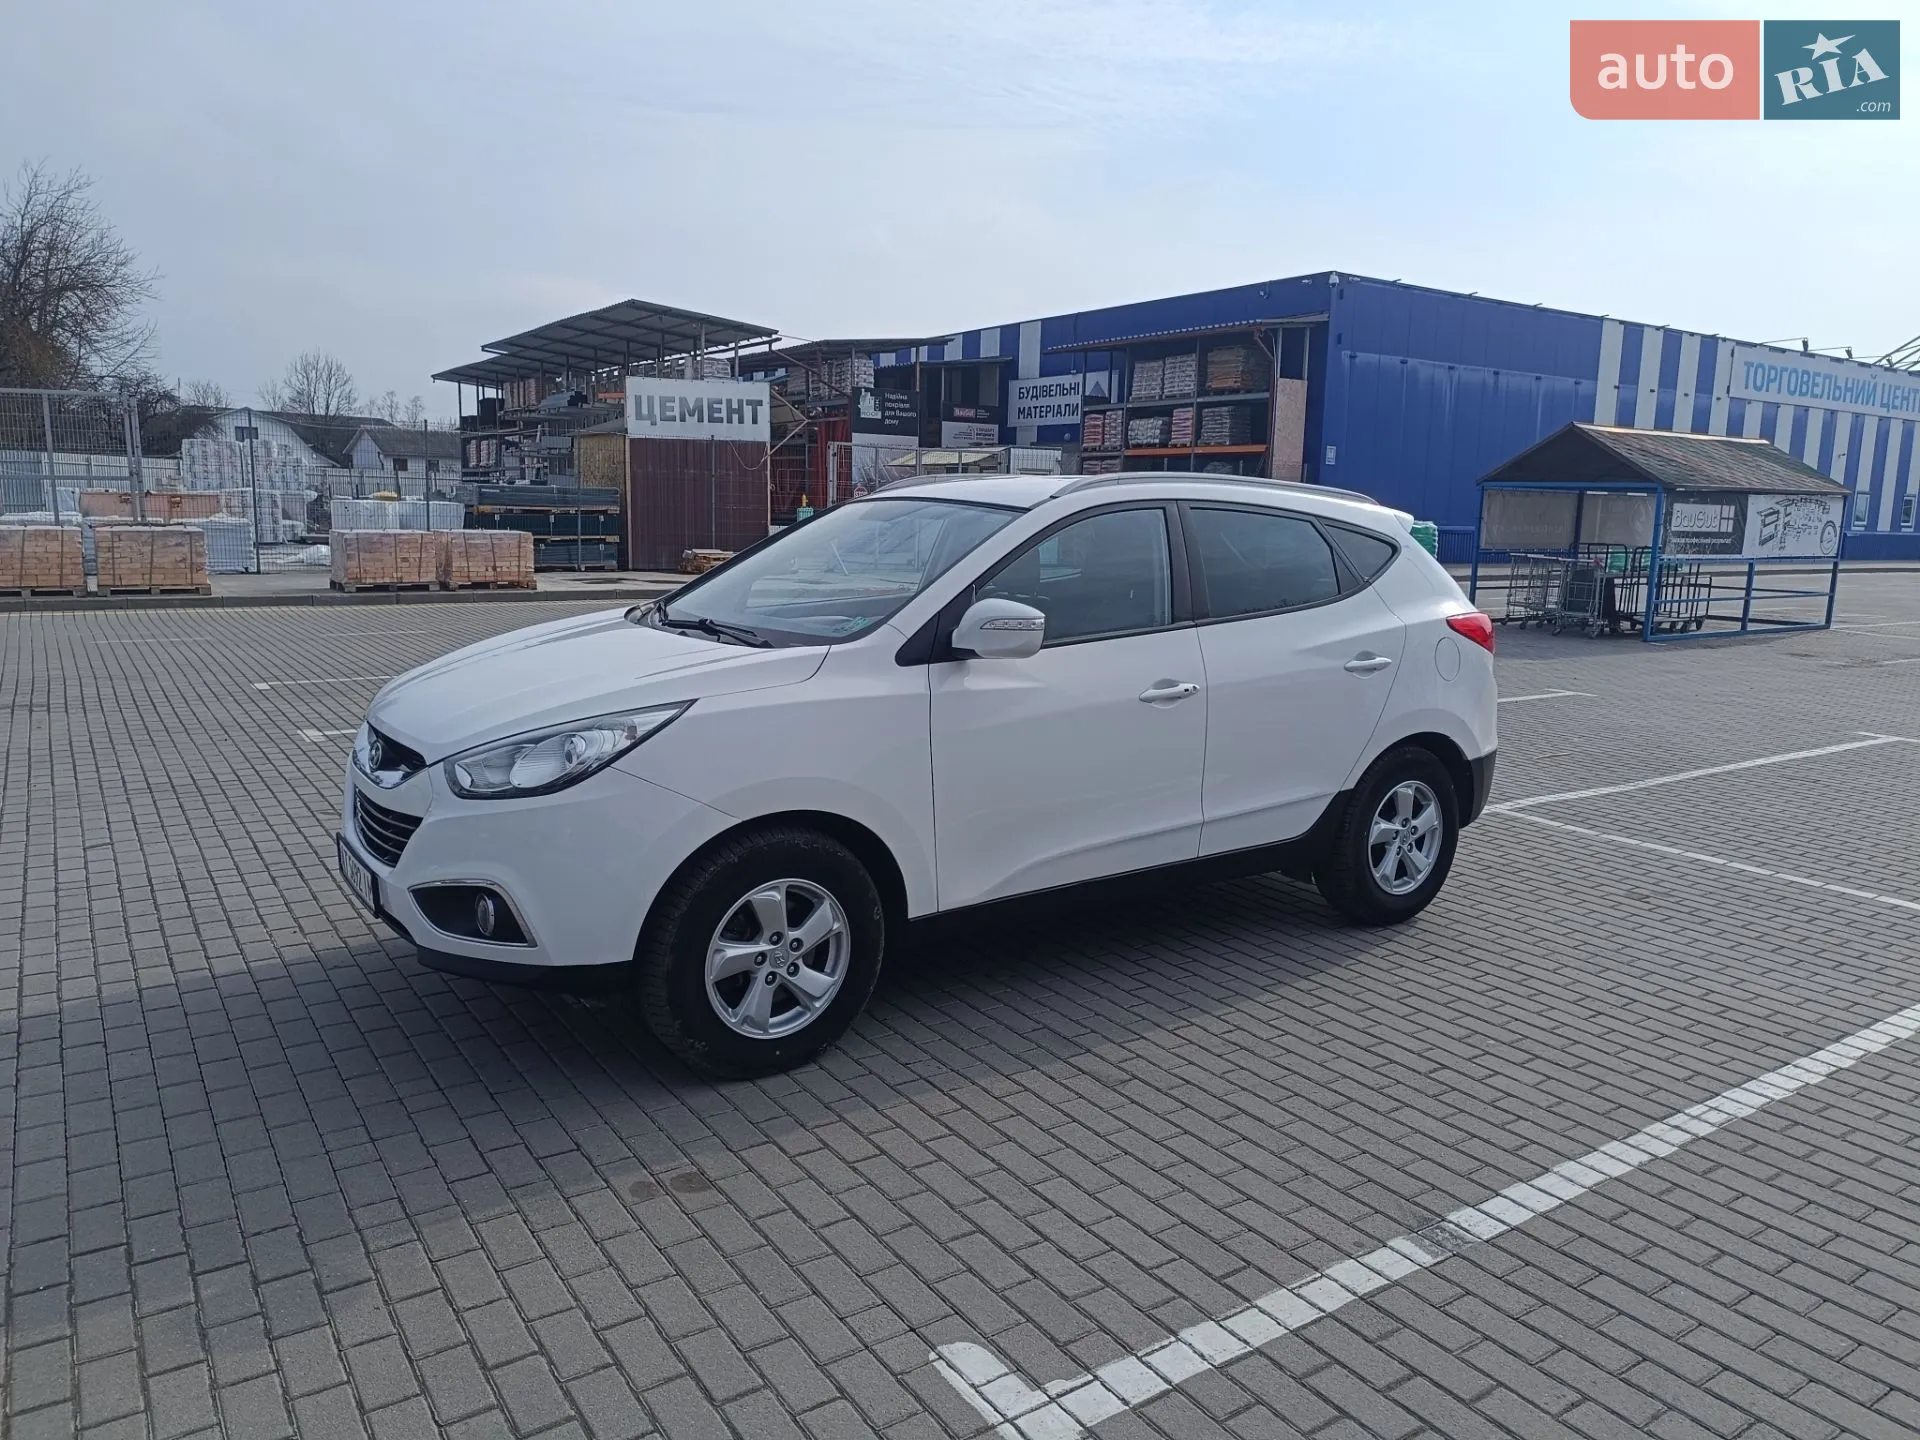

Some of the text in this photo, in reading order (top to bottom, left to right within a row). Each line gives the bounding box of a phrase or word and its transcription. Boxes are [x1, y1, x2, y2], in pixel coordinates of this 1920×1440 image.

[1018, 381, 1080, 402] БУДІВЕЛЬНІ
[1743, 361, 1877, 407] ТОРГОВЕЛЬНИЙ
[885, 392, 908, 400] Надійна
[634, 395, 763, 426] ЦЕМЕНТ
[1017, 403, 1080, 419] МАТЕРІАЛИ
